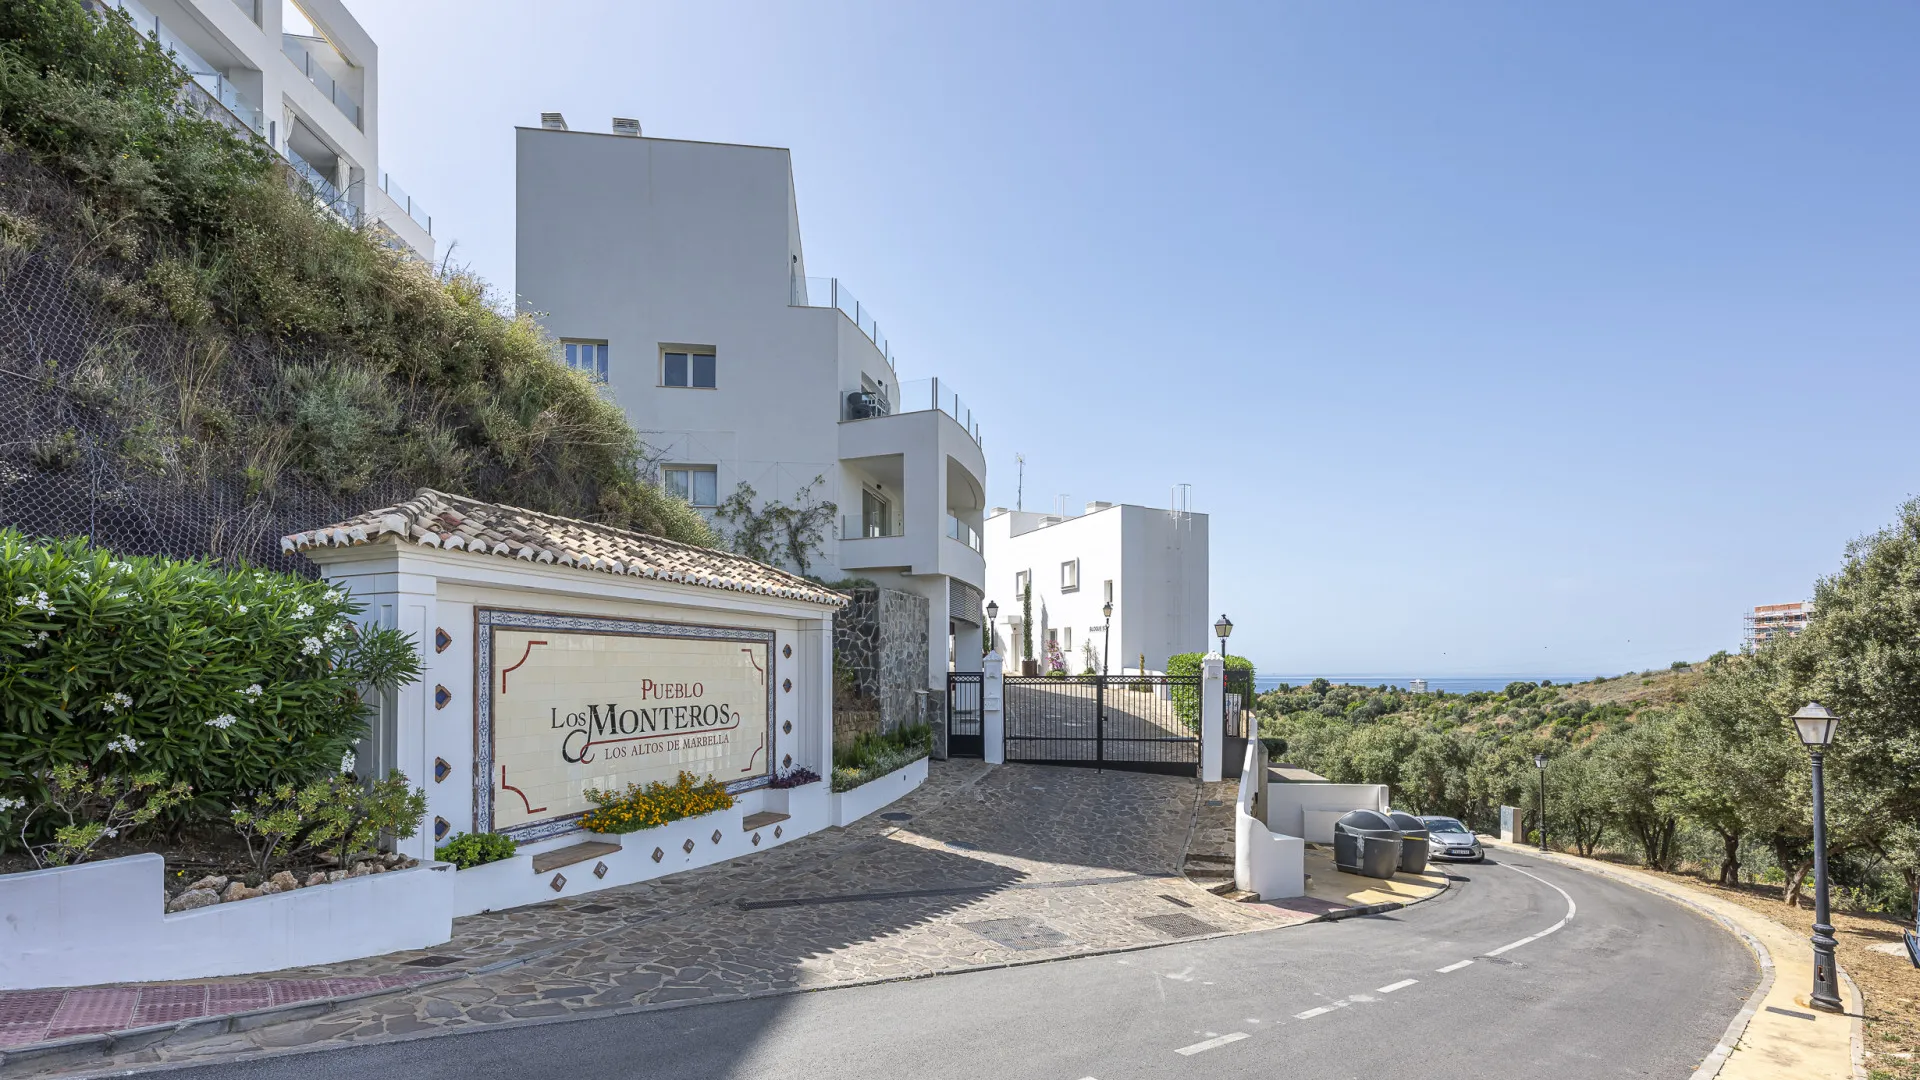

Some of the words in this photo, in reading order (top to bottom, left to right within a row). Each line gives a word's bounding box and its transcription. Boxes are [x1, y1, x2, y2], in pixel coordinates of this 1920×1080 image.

[641, 678, 703, 700] PUEBLO
[551, 707, 587, 729] LOS
[586, 703, 730, 745] MONTEROS
[605, 746, 627, 760] LOS
[631, 741, 664, 756] ALTOS
[667, 739, 680, 752] DE
[682, 734, 730, 750] MARBELLA
